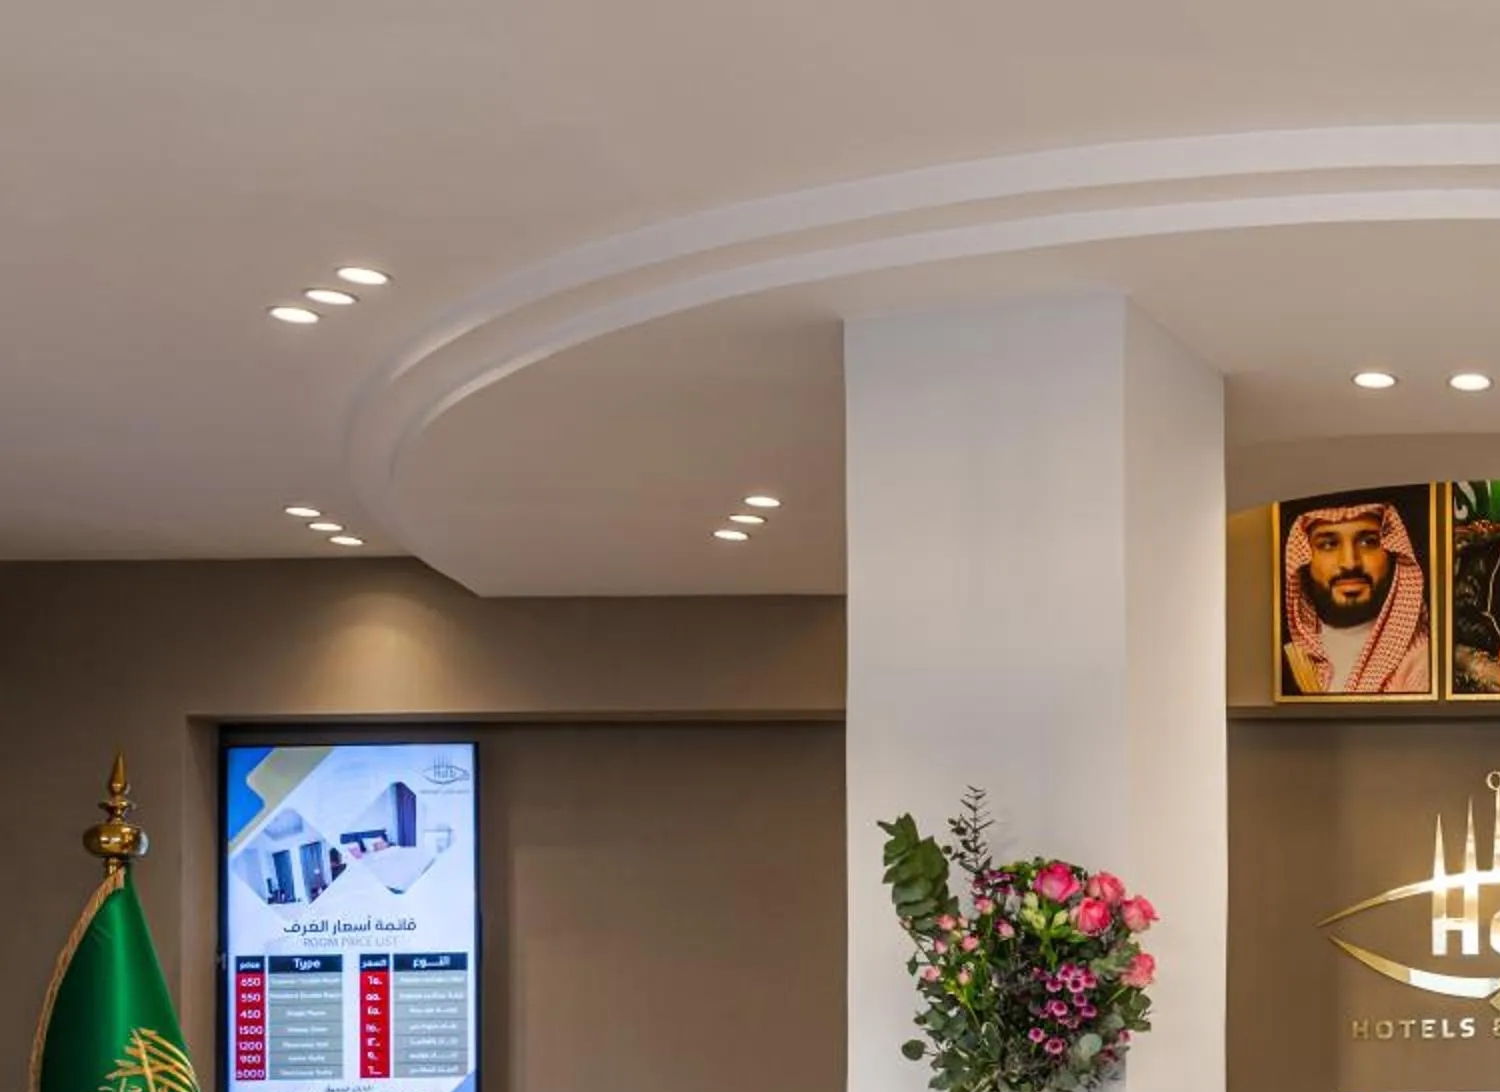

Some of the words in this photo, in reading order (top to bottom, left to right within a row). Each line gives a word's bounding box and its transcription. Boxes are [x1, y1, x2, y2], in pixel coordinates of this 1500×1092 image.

[284, 919, 329, 936] الغرف
[332, 915, 371, 935] أسعار
[292, 957, 322, 971] Type
[239, 1009, 261, 1019] 450
[1352, 1016, 1477, 1040] HOTELS
